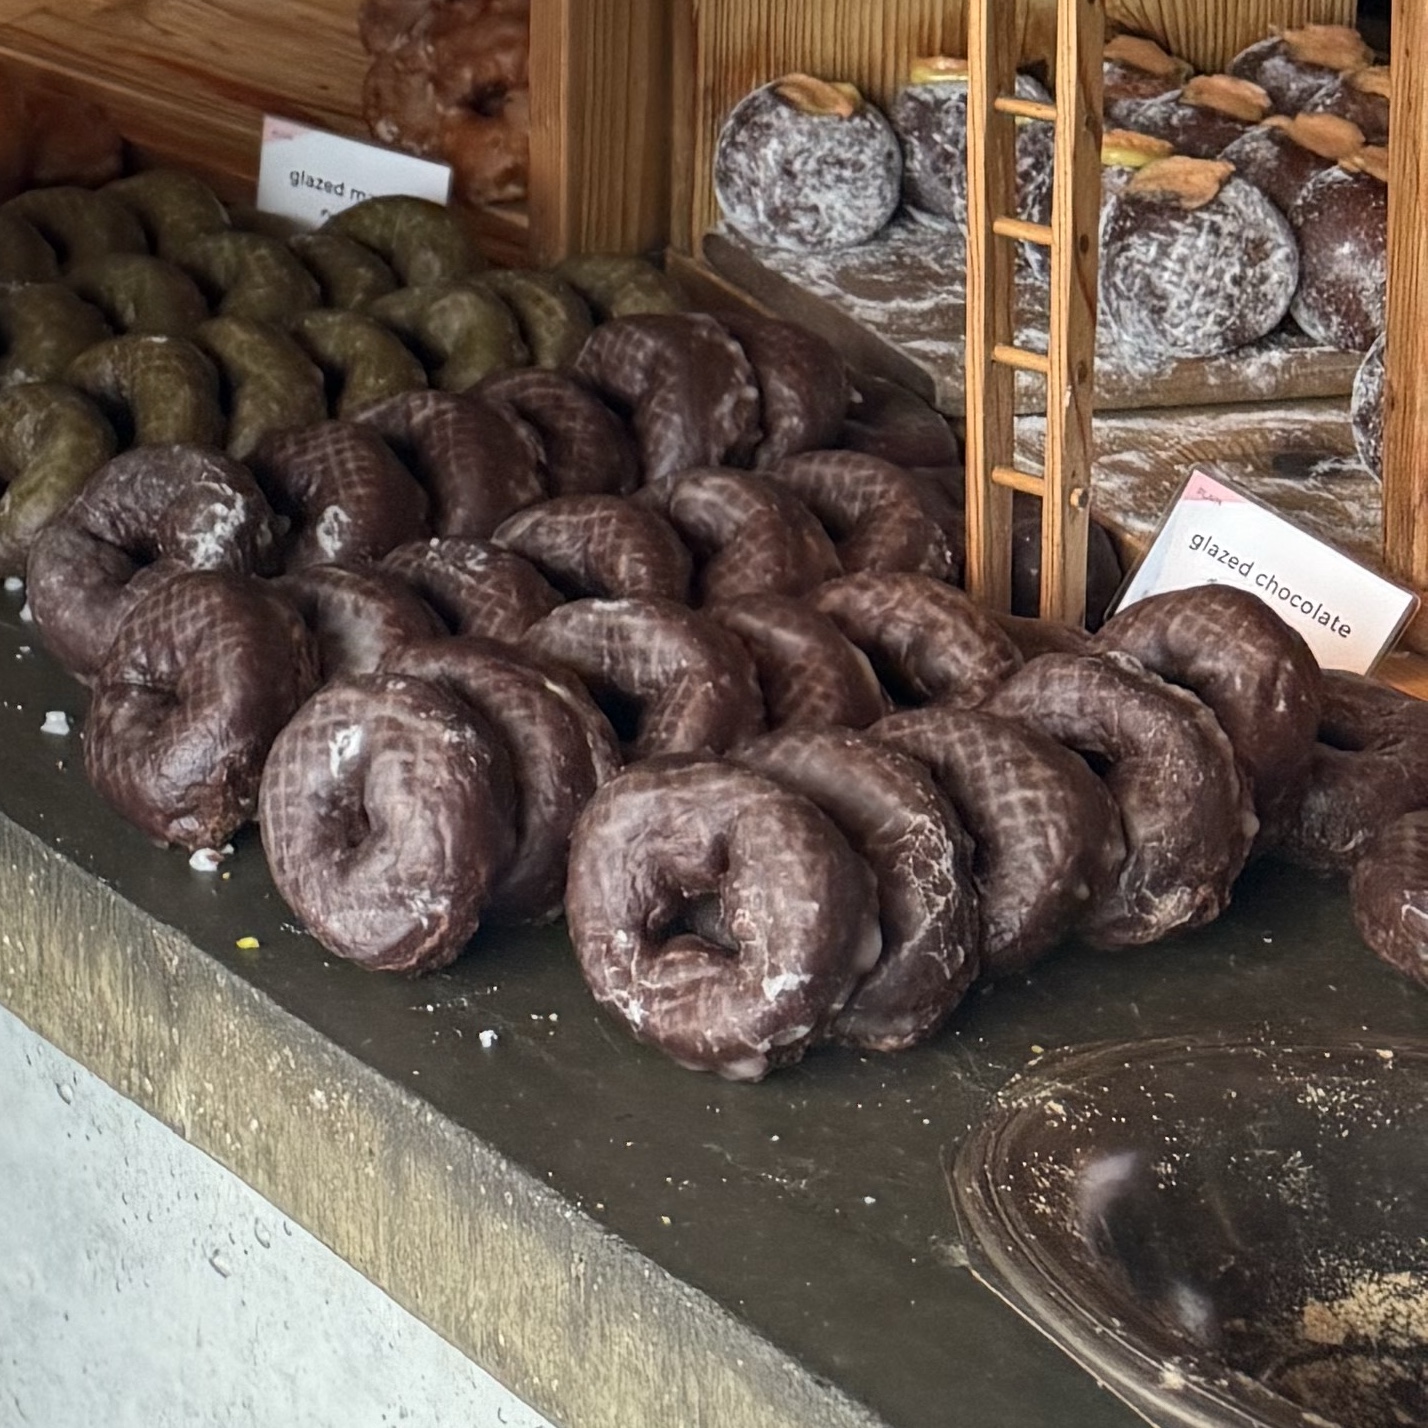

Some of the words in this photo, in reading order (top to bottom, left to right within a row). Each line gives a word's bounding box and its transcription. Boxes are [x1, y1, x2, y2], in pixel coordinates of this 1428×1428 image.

[289, 170, 345, 197] glazed
[1188, 532, 1255, 577] glazed
[1255, 574, 1352, 639] chocolate
